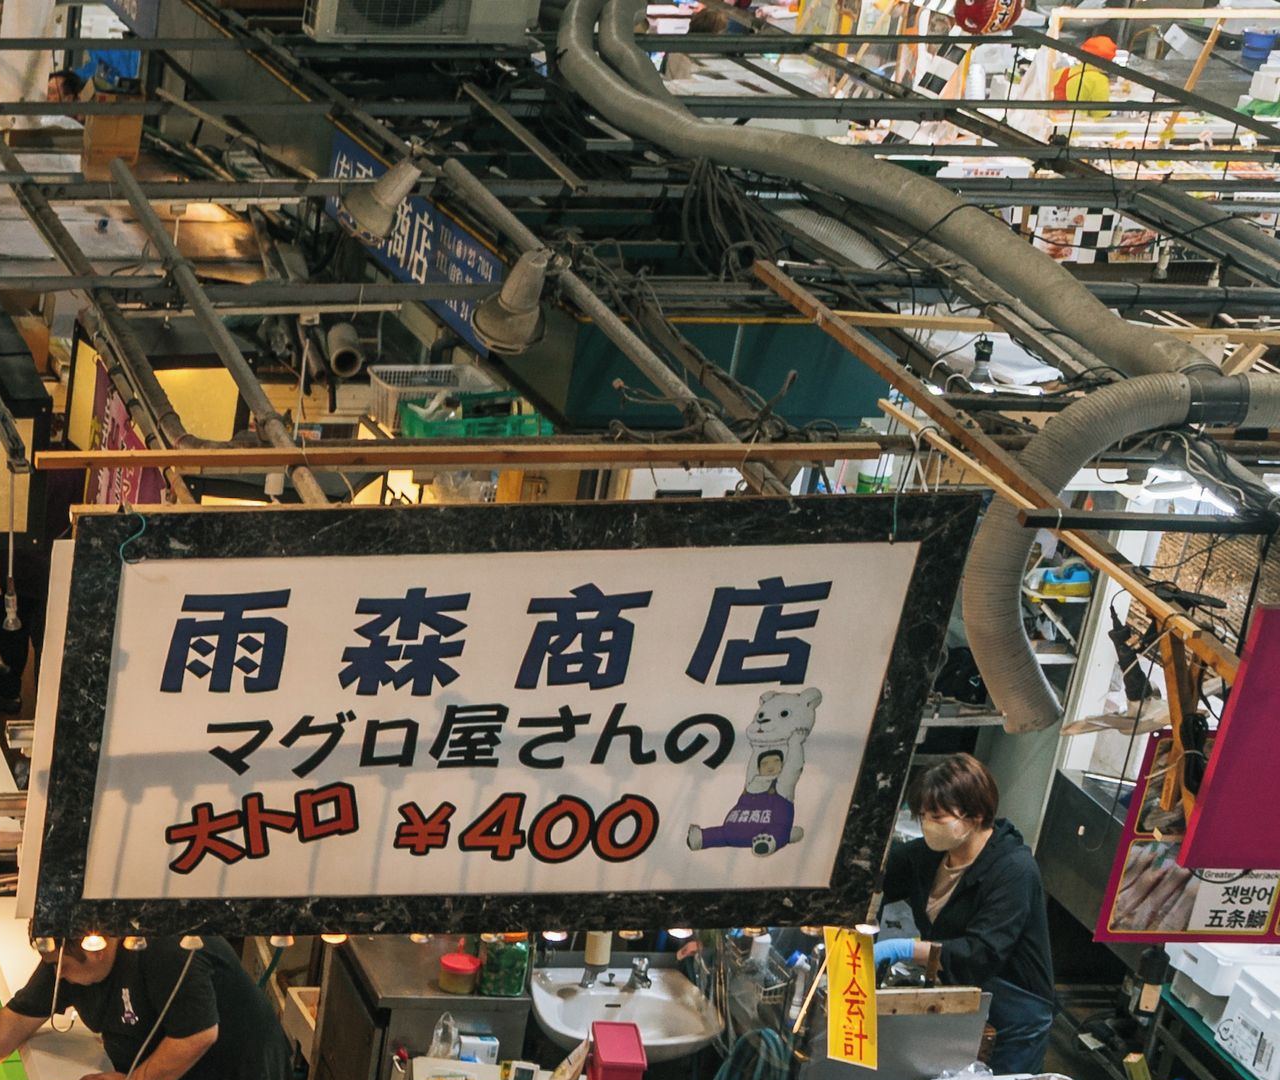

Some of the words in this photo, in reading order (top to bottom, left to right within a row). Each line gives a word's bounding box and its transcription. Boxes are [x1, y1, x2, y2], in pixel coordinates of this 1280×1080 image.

[159, 576, 833, 697] 雨森商店
[206, 702, 736, 778] マグロ屋さんの
[165, 782, 360, 875] 大トロ
[393, 792, 660, 864] ¥400
[727, 809, 771, 824] 雨森商店
[1204, 870, 1236, 880] Greater
[1221, 886, 1276, 905] 잿방어
[842, 942, 869, 1062] ¥会計
